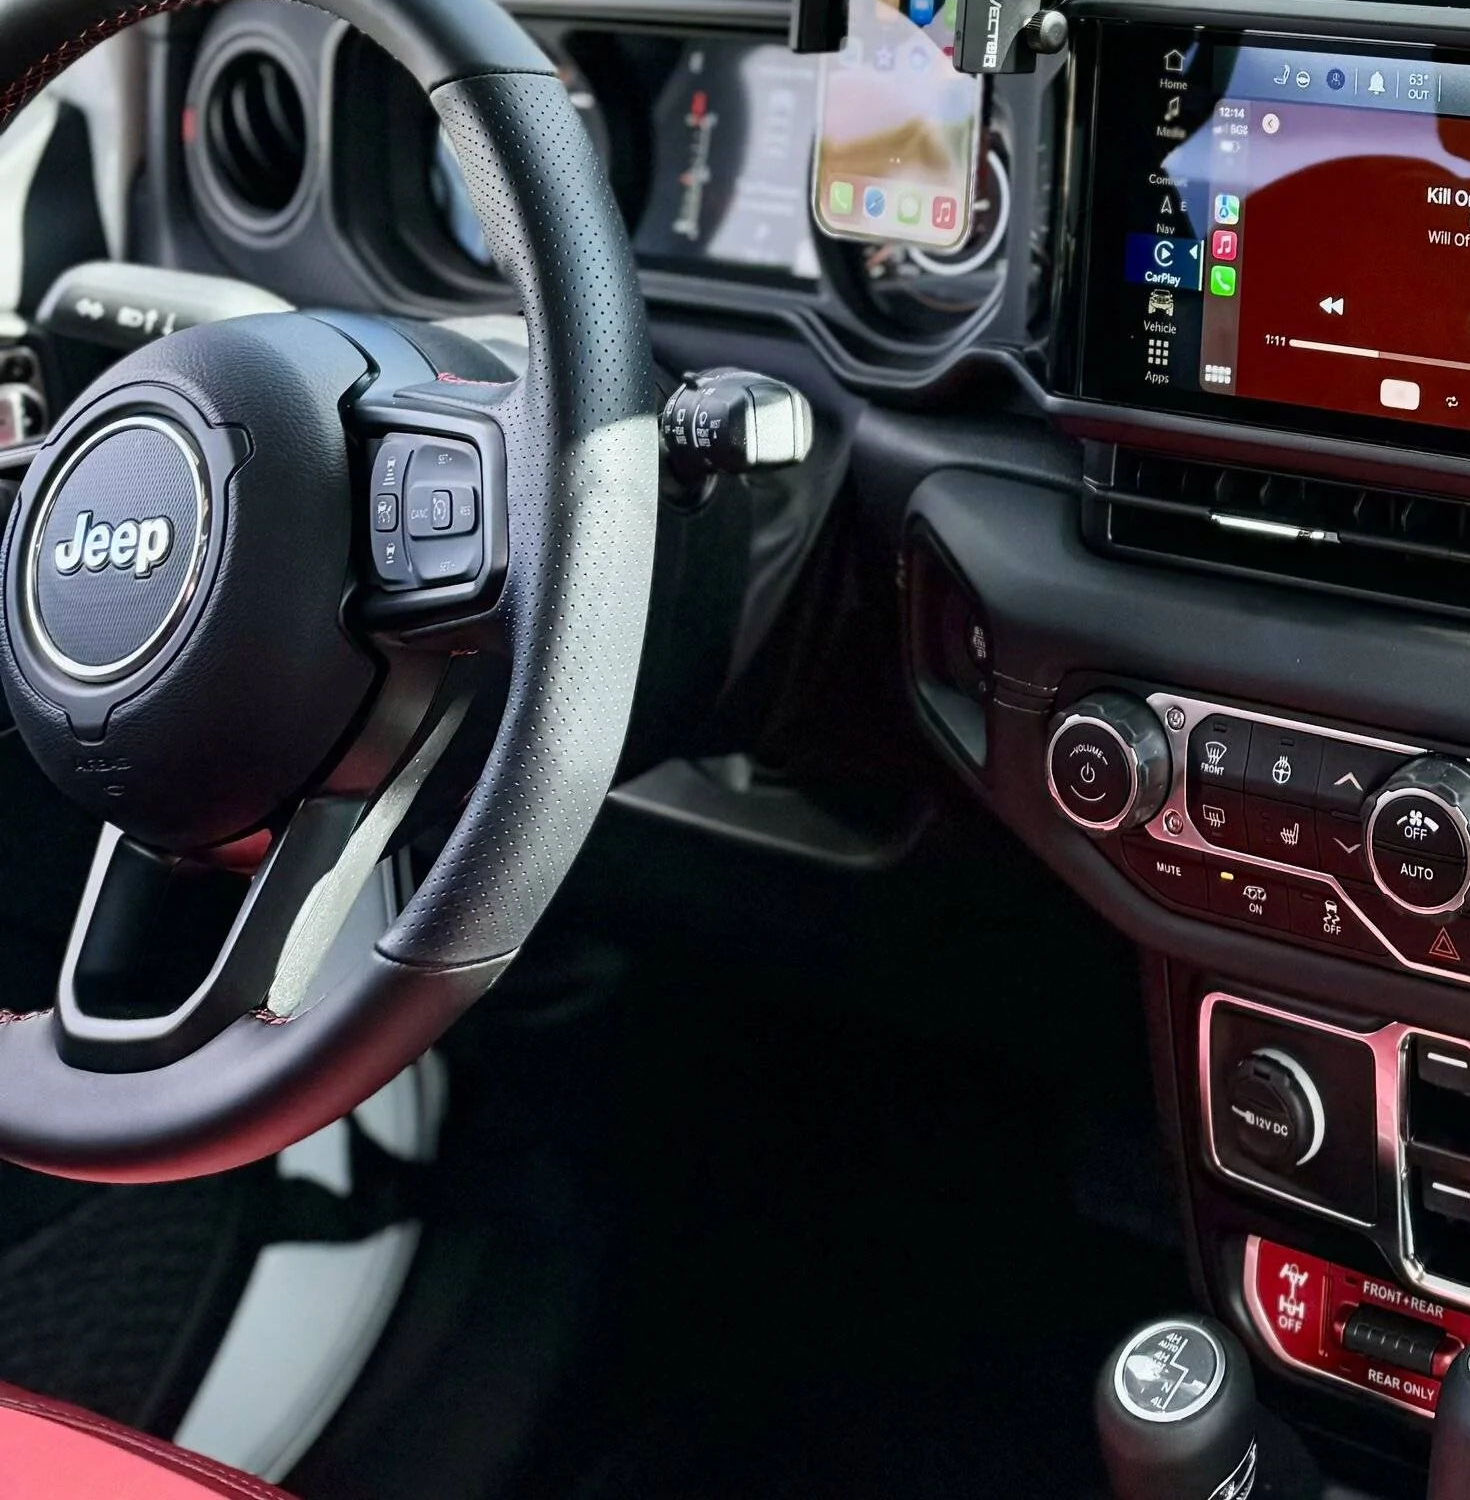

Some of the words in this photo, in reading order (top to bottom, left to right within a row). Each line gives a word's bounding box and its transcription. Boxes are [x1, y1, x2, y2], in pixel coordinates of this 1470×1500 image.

[1159, 78, 1188, 90] Home
[1407, 88, 1430, 100] OUT
[1218, 106, 1245, 118] 12:14
[1426, 186, 1451, 206] Kill
[1180, 201, 1188, 212] E
[1156, 223, 1175, 235] Nav
[1427, 229, 1451, 247] Will
[1453, 232, 1470, 248] Of
[1144, 271, 1181, 288] CarPlay
[1143, 320, 1177, 335] Vehicle
[1265, 334, 1287, 347] 1:11
[1144, 370, 1170, 385] Apps
[55, 510, 172, 576] Jeep
[1073, 743, 1105, 759] VOLUME
[1200, 762, 1226, 777] FRONT
[1403, 825, 1428, 842] OFF
[1156, 861, 1183, 878] MUTE
[1399, 862, 1435, 881] AUTO
[1248, 902, 1264, 916] ON
[1323, 923, 1343, 937] OFF
[1255, 1115, 1273, 1132] 12V
[1273, 1123, 1289, 1138] DC
[1278, 1316, 1304, 1333] OFF
[1165, 1332, 1182, 1345] 4H
[1157, 1340, 1179, 1353] AUTO
[1153, 1350, 1171, 1363] 4H
[1160, 1381, 1173, 1393] N
[1367, 1368, 1400, 1390] REAR
[1402, 1380, 1435, 1401] ONLY
